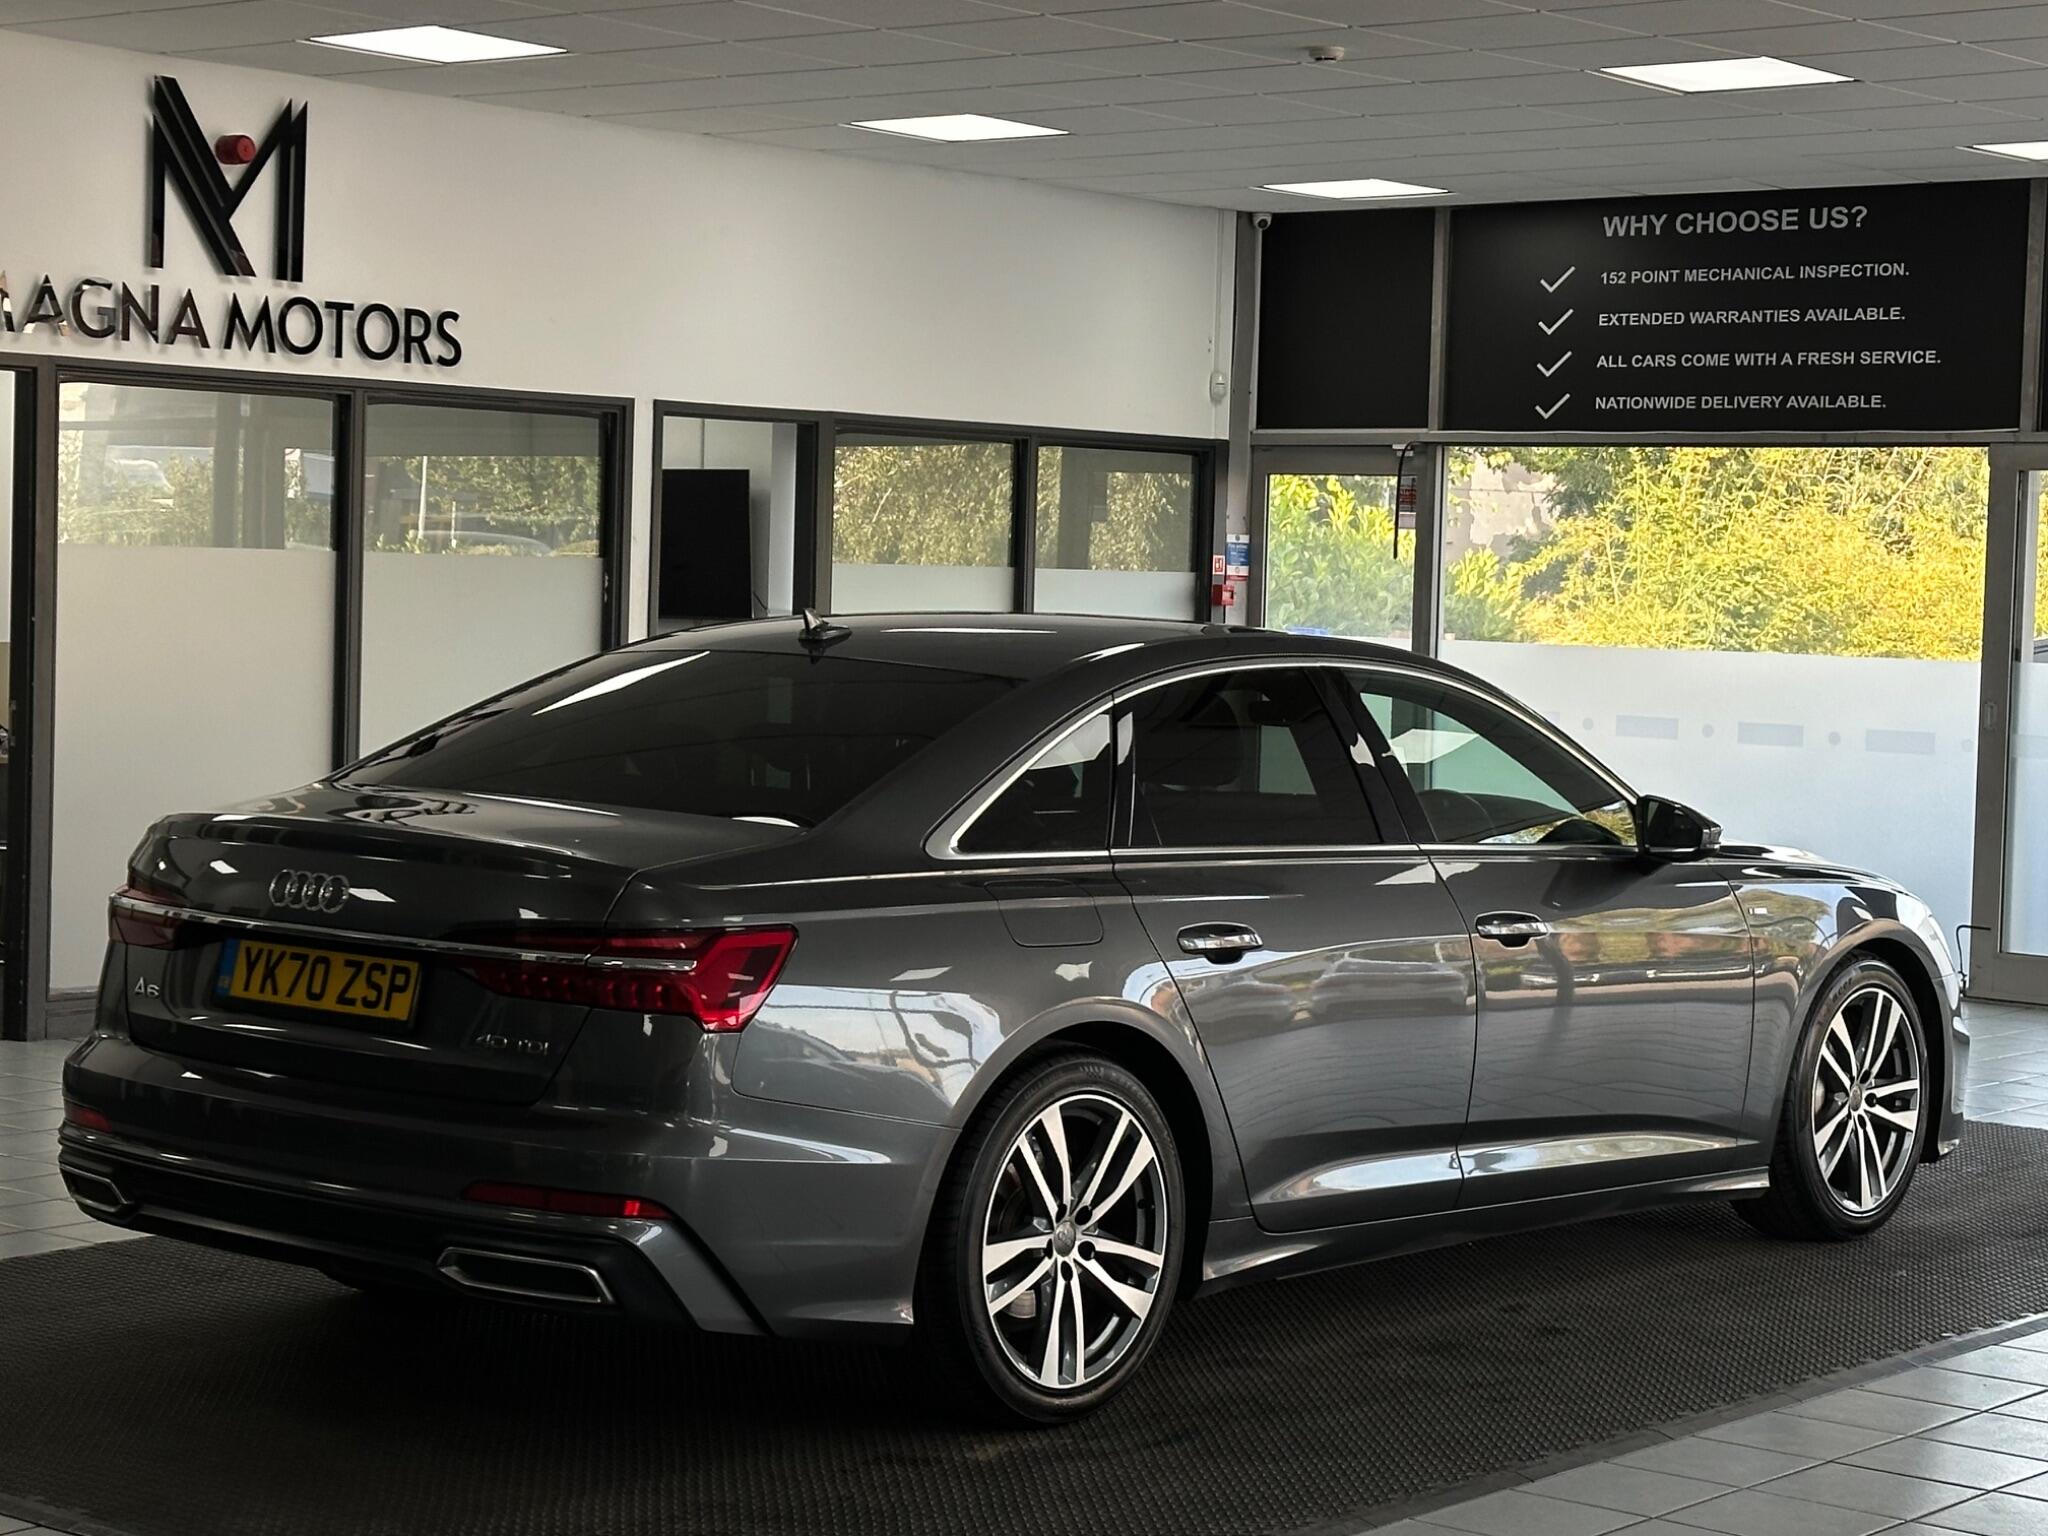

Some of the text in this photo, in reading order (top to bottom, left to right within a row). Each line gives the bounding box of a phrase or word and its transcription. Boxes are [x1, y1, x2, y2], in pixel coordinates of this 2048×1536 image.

[1603, 206, 1867, 237] WHY CHOOSE US?
[1601, 263, 1909, 285] 152 POINT MECHANICAL INSPECTION.
[1599, 307, 1905, 326] EXTENDED WARRANTIES AVAILABLE.
[223, 292, 463, 367] MOTORS
[1597, 350, 1941, 368] ALL CARS COME WITH A FRESH SERVICE.
[1596, 395, 1886, 409] NATIONWIDE DELIVERY AVAILABLE.
[134, 976, 160, 998] A6
[243, 946, 413, 1012] YK70 ZSP
